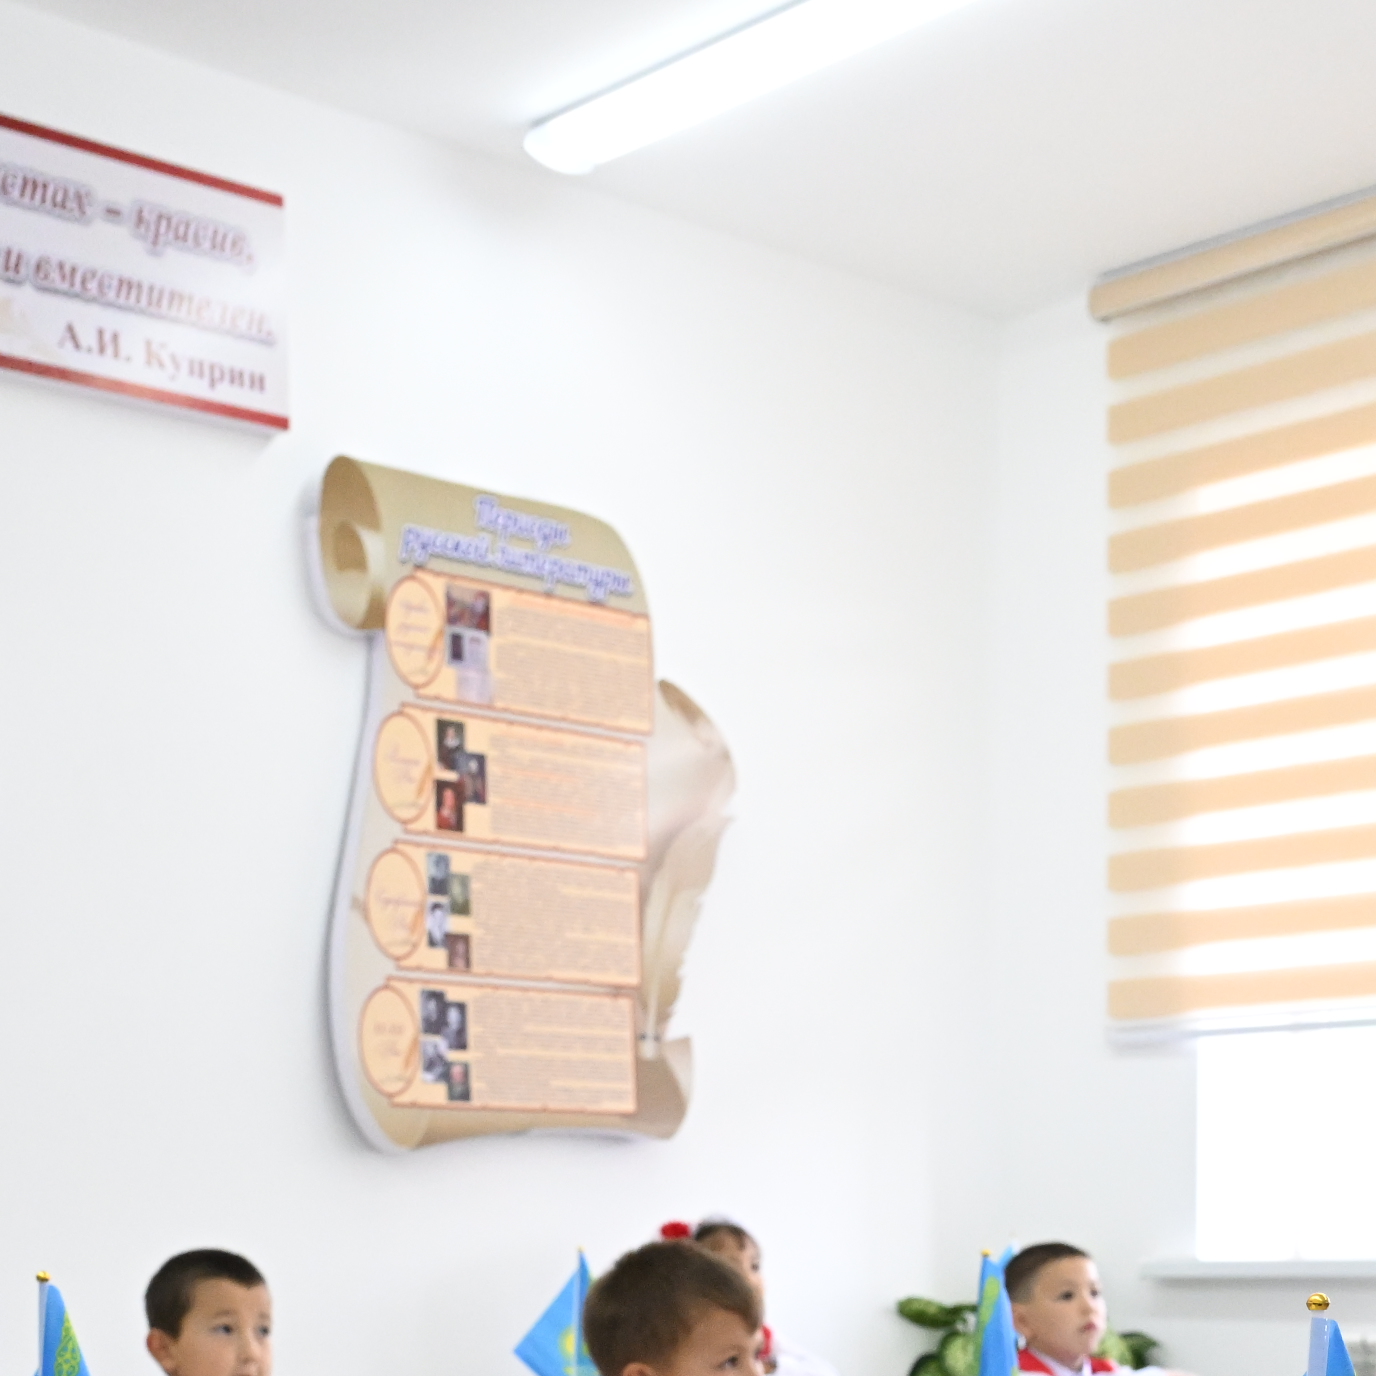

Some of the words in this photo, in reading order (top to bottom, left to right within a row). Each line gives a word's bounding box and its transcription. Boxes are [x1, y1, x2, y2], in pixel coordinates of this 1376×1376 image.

[135, 204, 254, 264] красив,
[3, 245, 22, 275] и
[34, 255, 273, 338] вместителен.
[58, 321, 131, 362] А.И.
[145, 338, 267, 393] Куприн
